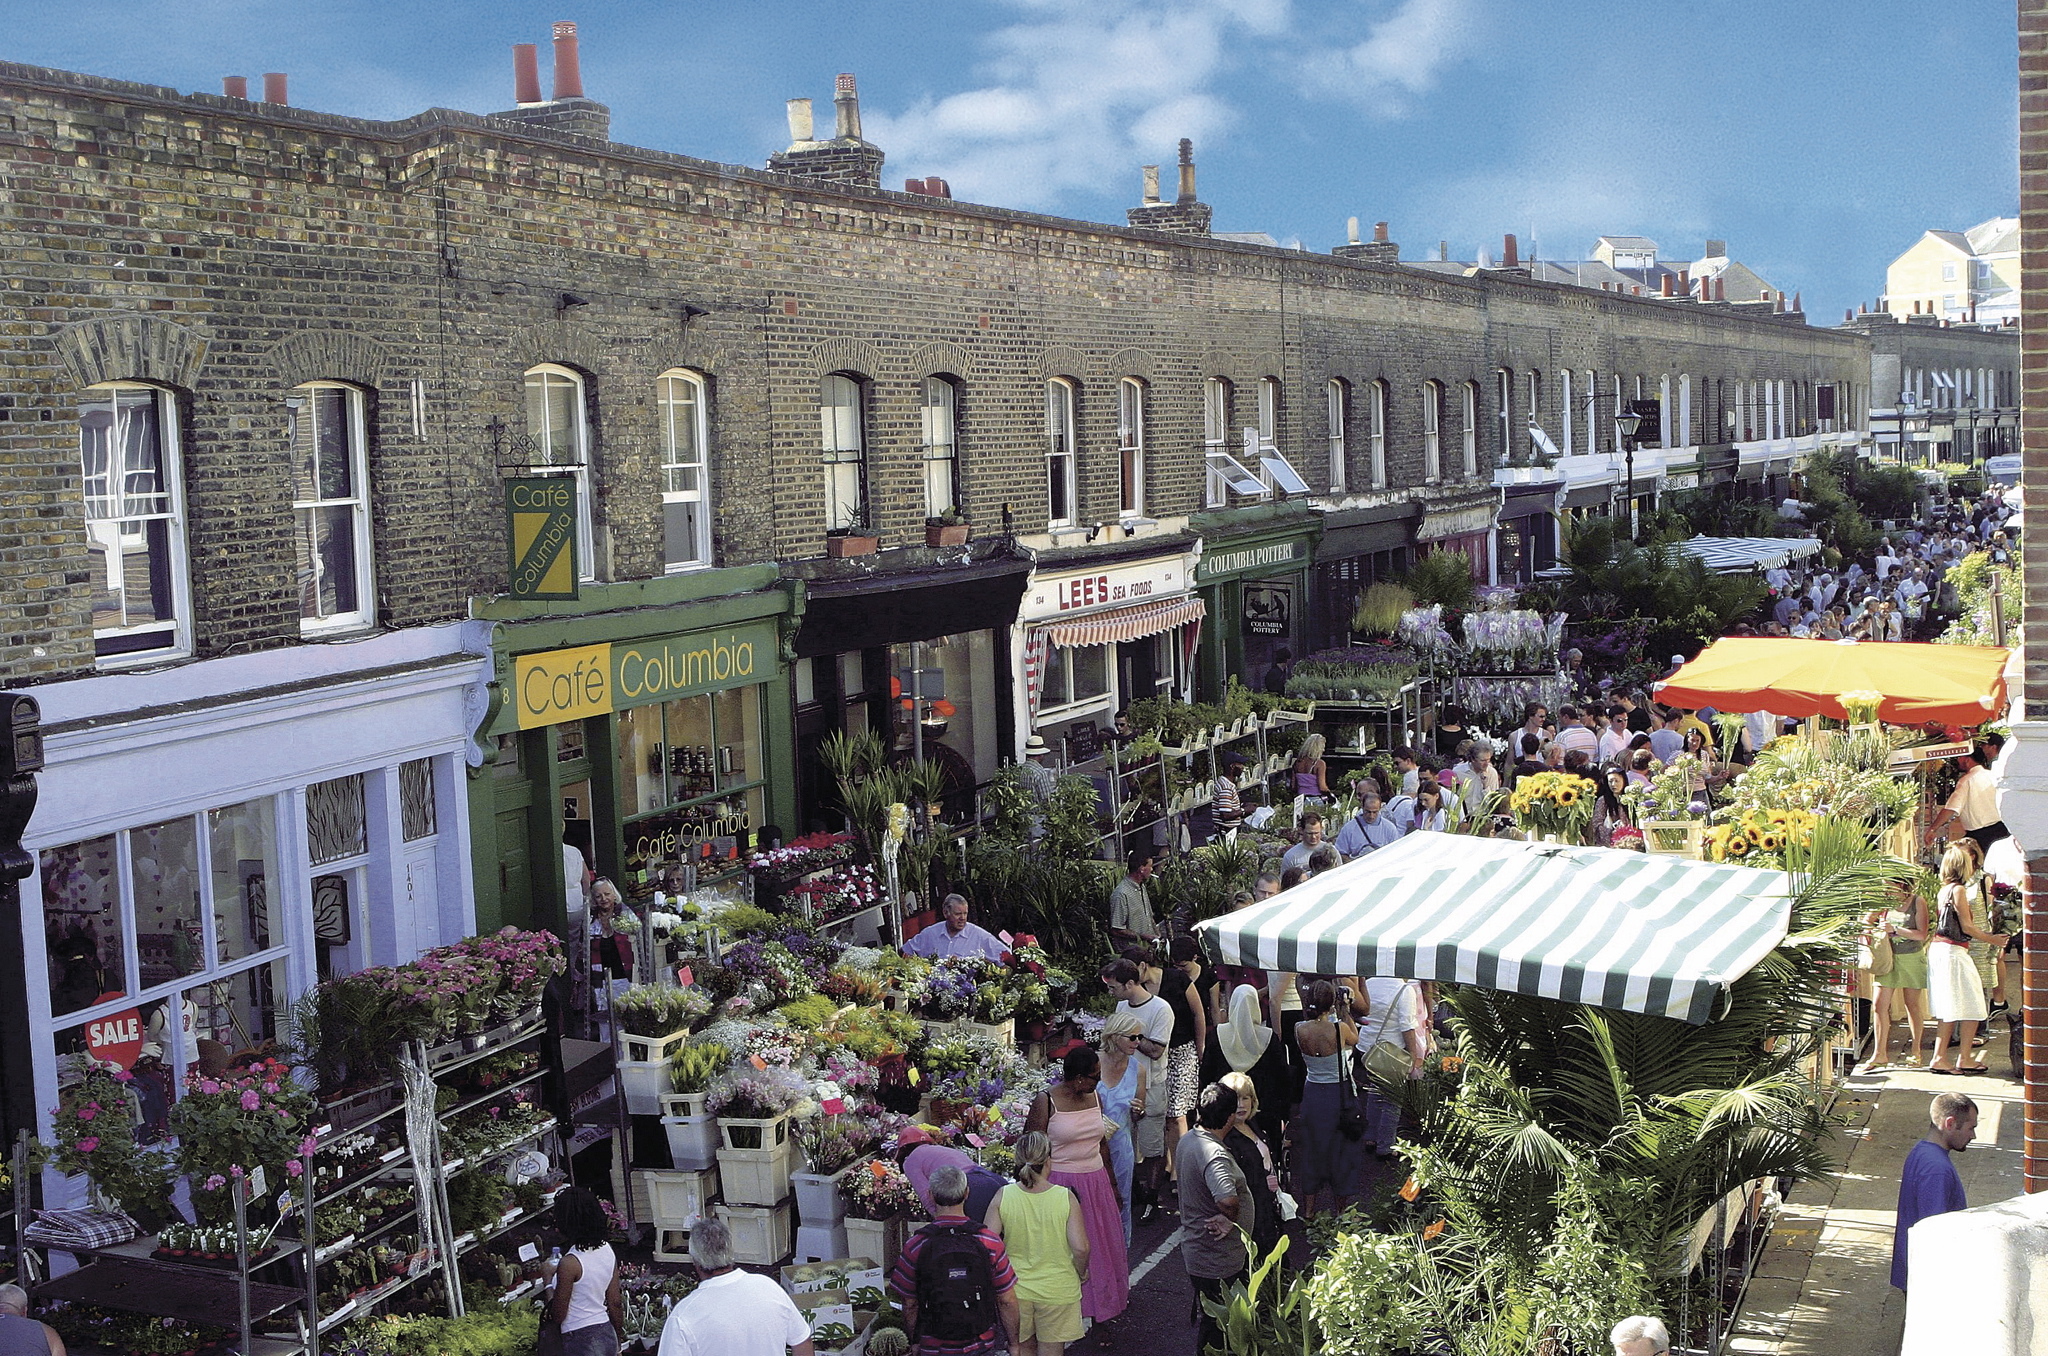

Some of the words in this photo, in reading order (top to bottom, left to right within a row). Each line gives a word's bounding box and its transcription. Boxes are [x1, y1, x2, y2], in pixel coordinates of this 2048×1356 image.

[512, 483, 570, 508] Café
[514, 511, 572, 595] Columbia
[1208, 549, 1256, 574] COLUMBIA
[1256, 542, 1294, 565] POTTERY
[1035, 596, 1045, 605] 134
[1058, 575, 1108, 611] LEE'S
[1112, 585, 1126, 600] SEA
[1129, 580, 1153, 598] FOODS
[1250, 621, 1283, 629] COLUMBIA
[524, 654, 604, 716] Café
[620, 635, 754, 699] Columbia
[636, 826, 676, 862] Café
[680, 811, 751, 848] Columbia
[89, 1017, 140, 1048] SALE
